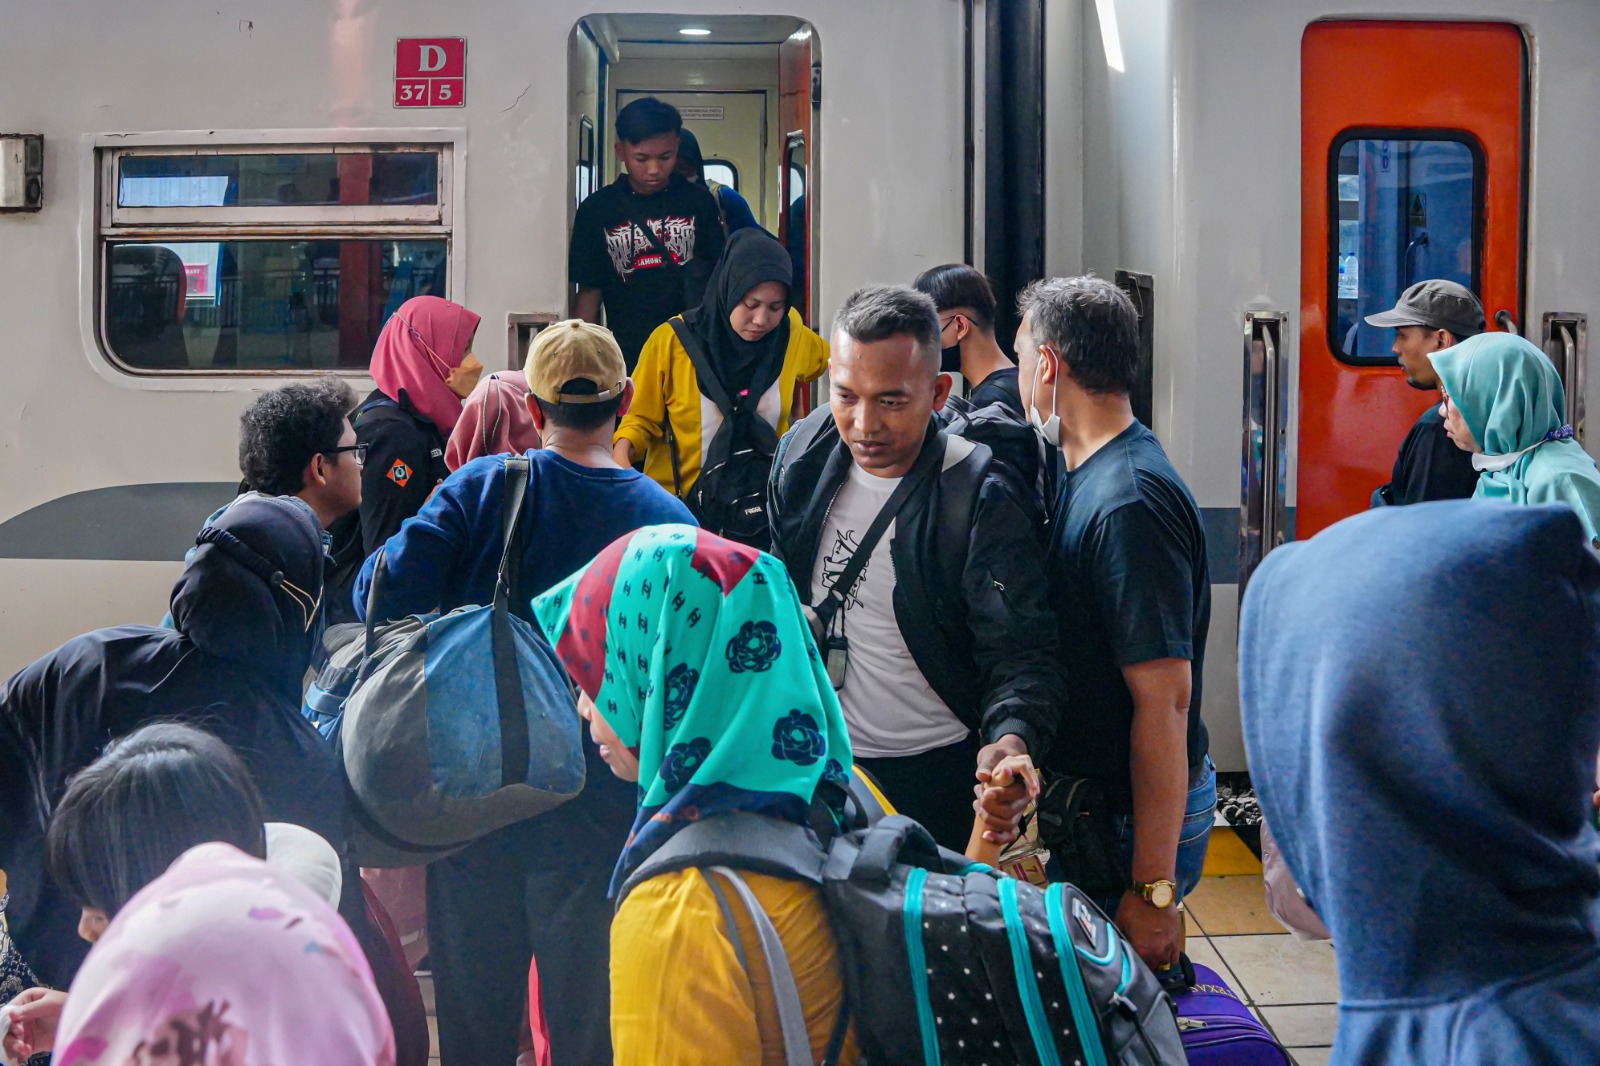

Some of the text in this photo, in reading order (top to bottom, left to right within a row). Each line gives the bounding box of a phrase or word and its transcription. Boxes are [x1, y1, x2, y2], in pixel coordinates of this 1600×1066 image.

[418, 45, 446, 72] D
[400, 84, 452, 101] 37 5
